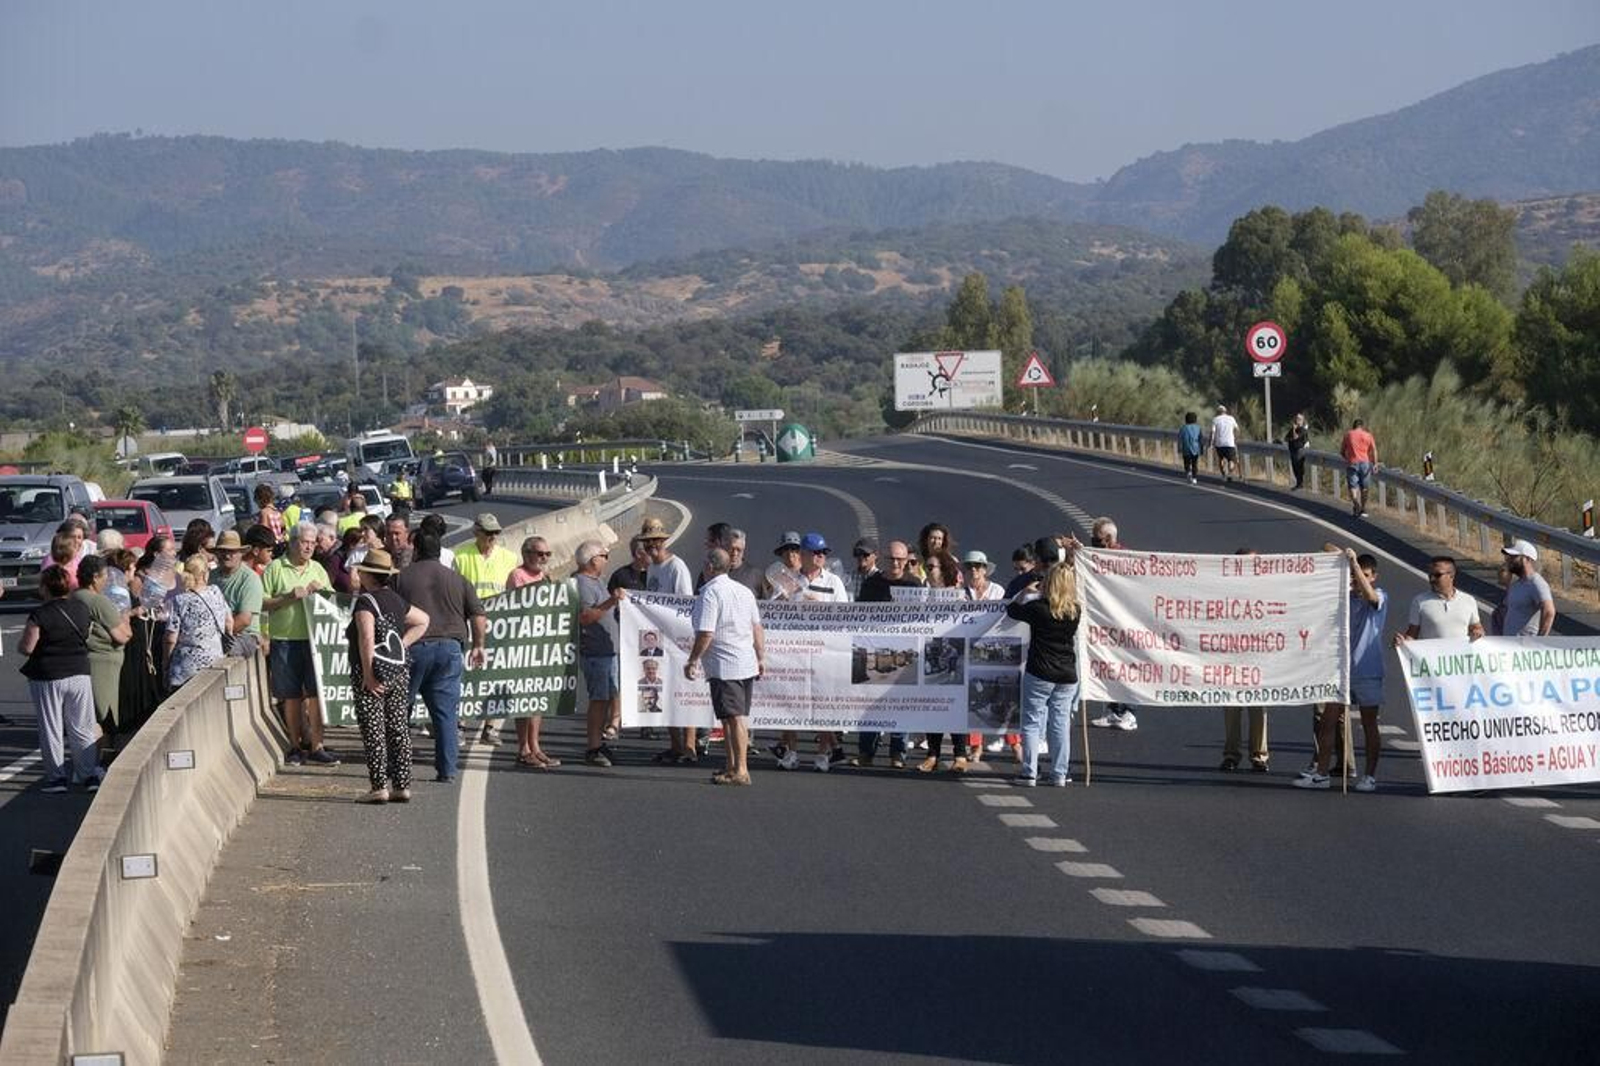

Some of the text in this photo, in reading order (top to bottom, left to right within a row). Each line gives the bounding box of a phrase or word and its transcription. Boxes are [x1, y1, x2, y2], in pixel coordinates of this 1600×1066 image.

[1256, 336, 1278, 349] 60
[1091, 554, 1146, 576] Servicios
[1150, 554, 1197, 577] Basicos
[1253, 555, 1315, 576] Barriadas
[630, 595, 642, 605] EL
[759, 603, 798, 613] RDOBA
[801, 603, 835, 613] SIGUE
[837, 604, 900, 614] SUFRIENDO
[904, 605, 920, 613] UN
[924, 604, 956, 613] TOTAL
[485, 613, 571, 640] POTABLE
[762, 612, 805, 621] ACTUAL
[808, 612, 867, 622] GOBIERNO
[869, 613, 930, 623] MUNICIPAL
[934, 614, 950, 624] PP
[951, 614, 959, 624] Y
[847, 624, 859, 633] SIN
[860, 625, 901, 635] SERVICIOS
[1088, 625, 1310, 653] DESARROLLO ECONOMICO Y
[482, 643, 576, 671] FAMILIAS
[1410, 656, 1431, 678] LA
[1433, 652, 1485, 677] JUNTA
[1488, 651, 1508, 674] DE
[1090, 660, 1262, 687] CREACION DE EMPLEO
[478, 676, 577, 697] EXTRARRADIO
[1236, 687, 1300, 703] CORDOBA
[1302, 684, 1340, 699] EXTRA
[1412, 686, 1456, 712] EL
[1464, 680, 1563, 711] AGUA
[487, 697, 548, 715] BASICOS
[842, 719, 898, 729] EXTRARRADIO
[1424, 719, 1480, 743] ERECHO
[1483, 713, 1559, 739] UNIVERSAL
[1432, 744, 1597, 779] rvicios Básicos = AGUA Y
